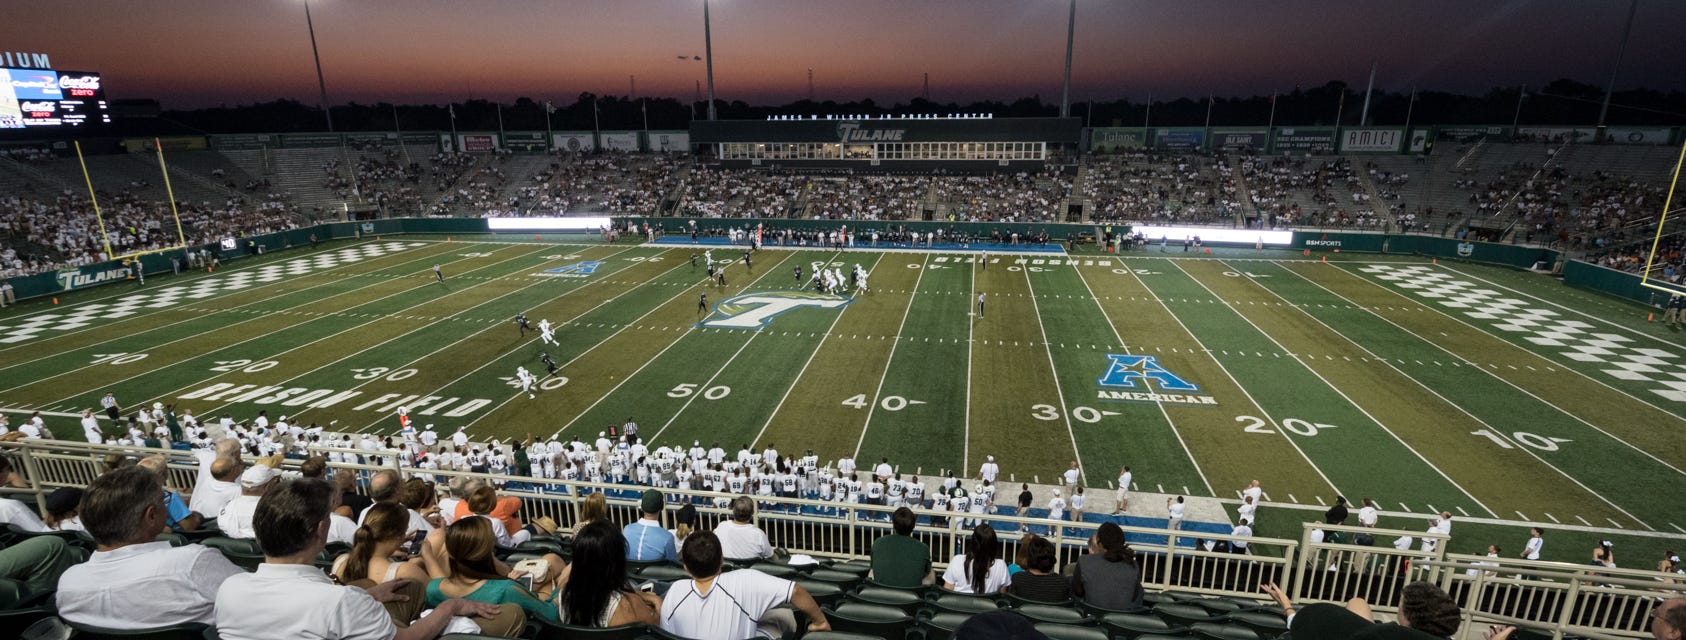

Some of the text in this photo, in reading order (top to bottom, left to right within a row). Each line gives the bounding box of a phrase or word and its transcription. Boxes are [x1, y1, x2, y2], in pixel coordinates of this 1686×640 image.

[1103, 131, 1136, 142] Tulane
[1349, 131, 1395, 145] AMICI
[209, 359, 279, 373] 20
[353, 366, 418, 381] 30
[176, 382, 493, 417] BENSON FIELD
[666, 383, 731, 400] 50
[1097, 390, 1218, 404] AMERICAN
[841, 394, 907, 411] 40
[1031, 403, 1102, 423] 30
[1235, 415, 1319, 437] 20
[1470, 429, 1559, 451] 10
